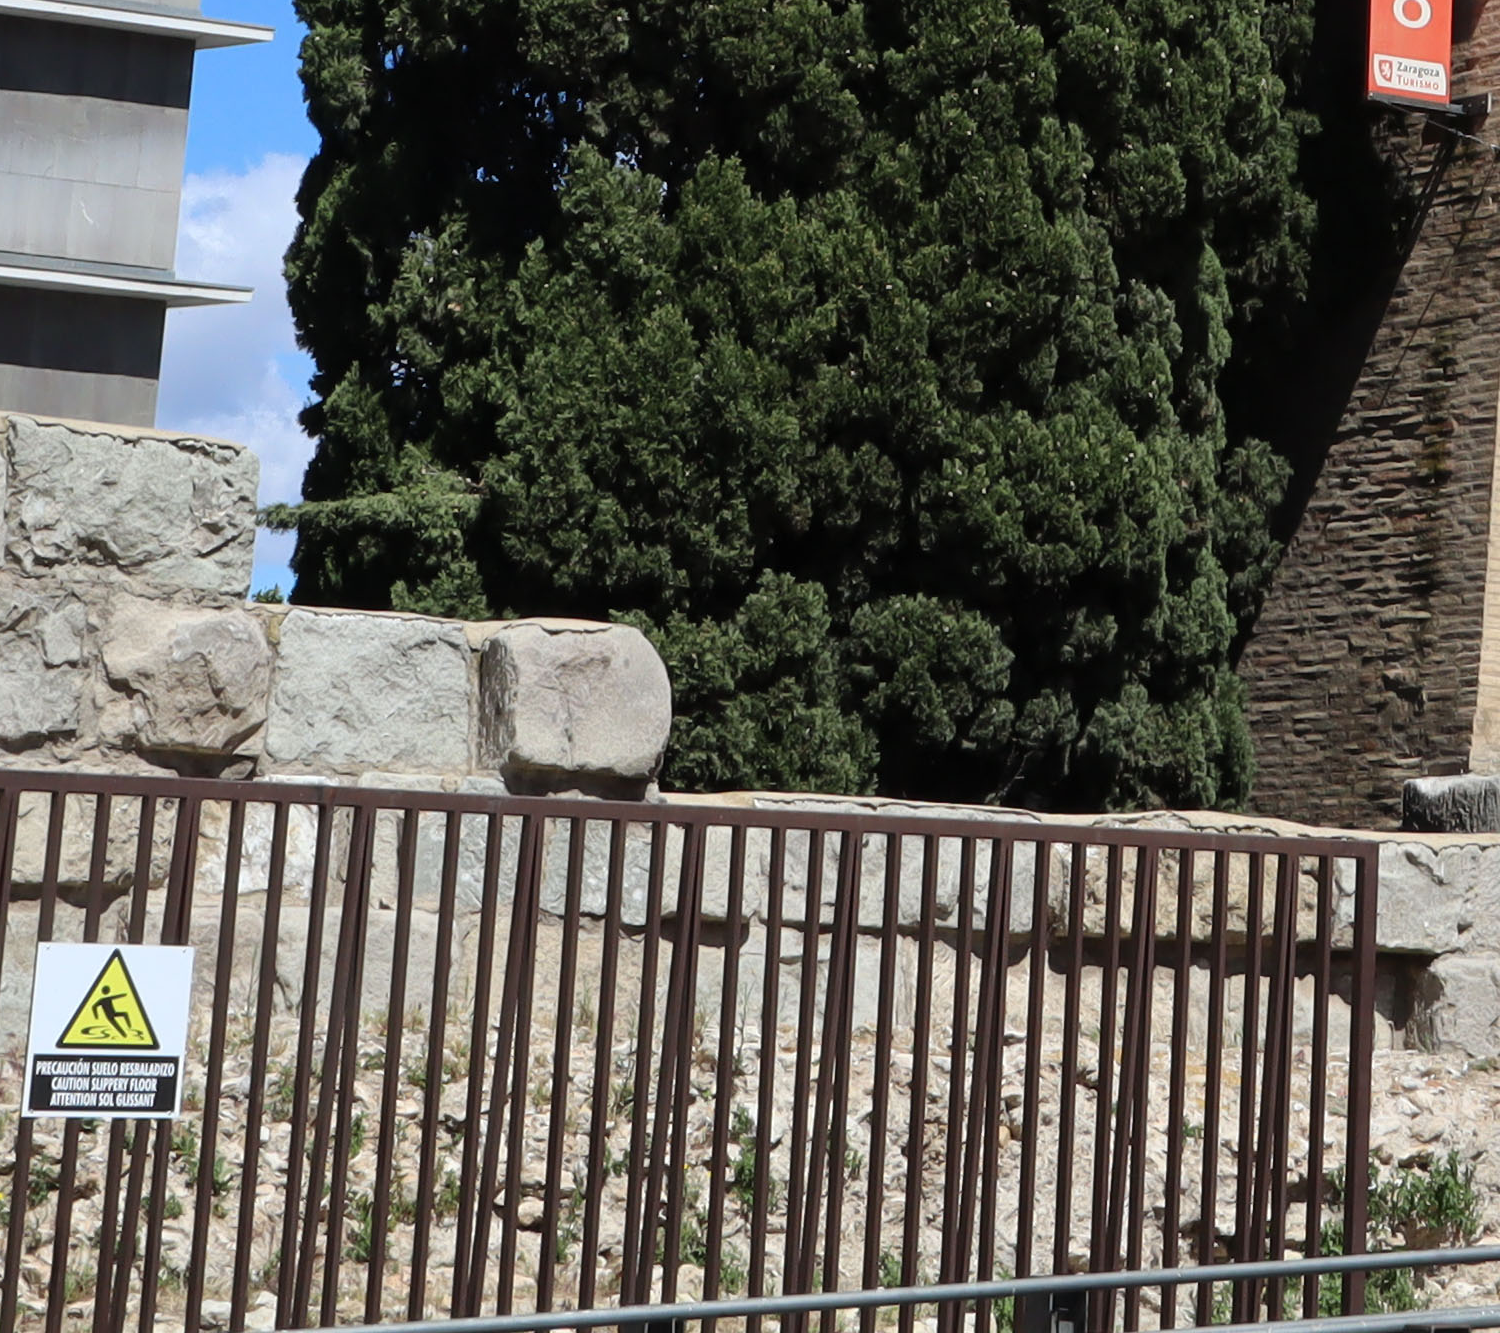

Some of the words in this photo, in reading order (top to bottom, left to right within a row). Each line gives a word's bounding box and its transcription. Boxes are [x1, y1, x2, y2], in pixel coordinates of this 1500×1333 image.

[1396, 61, 1440, 79] Zaragoza
[35, 1059, 90, 1076] PRECAUCIÓN
[91, 1062, 119, 1076] SUELO
[119, 1062, 175, 1077] RESBALADIZO
[51, 1077, 90, 1091] CAUTION
[91, 1078, 129, 1092] SLIPPERY
[130, 1078, 158, 1092] FLOOR
[50, 1092, 98, 1106] ATTENTION
[98, 1093, 114, 1106] SOL
[115, 1093, 156, 1108] GLISSANT
